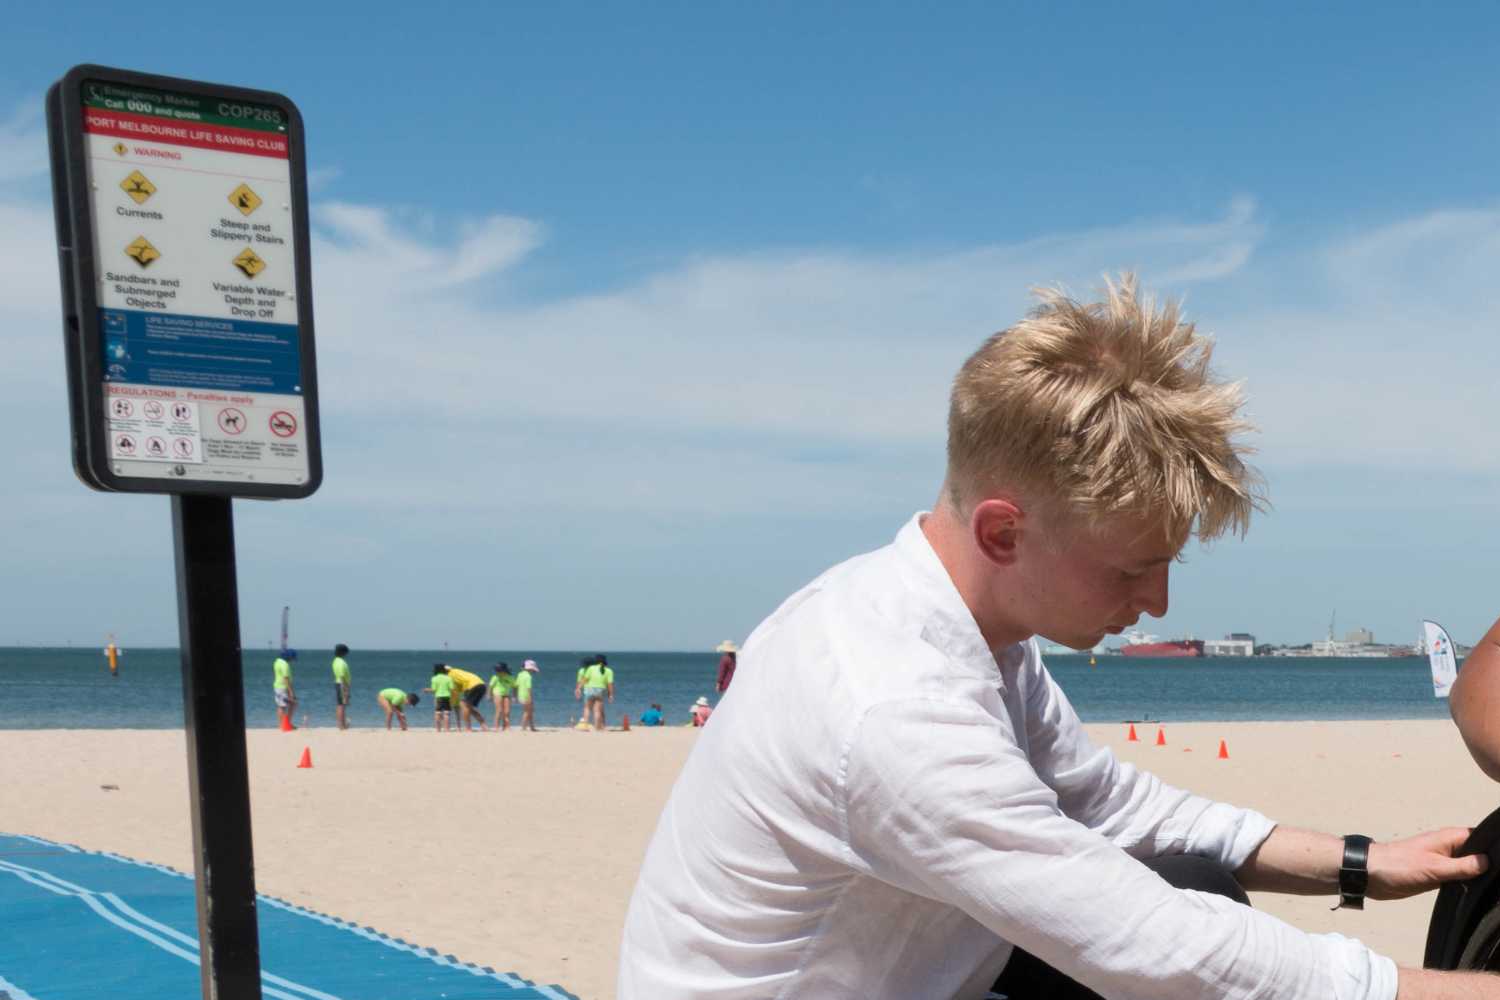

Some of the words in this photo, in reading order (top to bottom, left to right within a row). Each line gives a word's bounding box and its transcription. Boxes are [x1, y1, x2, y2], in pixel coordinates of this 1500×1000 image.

[105, 99, 125, 109] Call
[127, 100, 152, 113] 000
[155, 107, 173, 116] and
[218, 103, 281, 124] COP265
[87, 116, 116, 129] PORT
[118, 120, 188, 138] MELBOURNE
[190, 130, 213, 142] LIFE
[215, 134, 256, 148] SAVING
[256, 140, 286, 152] CLUB
[134, 146, 182, 160] WARNING
[116, 206, 164, 221] Currents
[220, 218, 250, 232] Steep
[252, 222, 271, 232] and
[210, 228, 253, 243] Slippery
[255, 233, 285, 245] Stairs
[106, 272, 158, 285] Sandbars
[160, 277, 181, 288] and
[115, 284, 177, 299] Submerged
[212, 282, 255, 295] Variable
[256, 286, 286, 298] Water
[126, 296, 167, 310] Objects
[224, 294, 255, 306] Depth
[257, 297, 276, 307] and
[231, 306, 257, 319] Drop
[258, 308, 275, 319] Off
